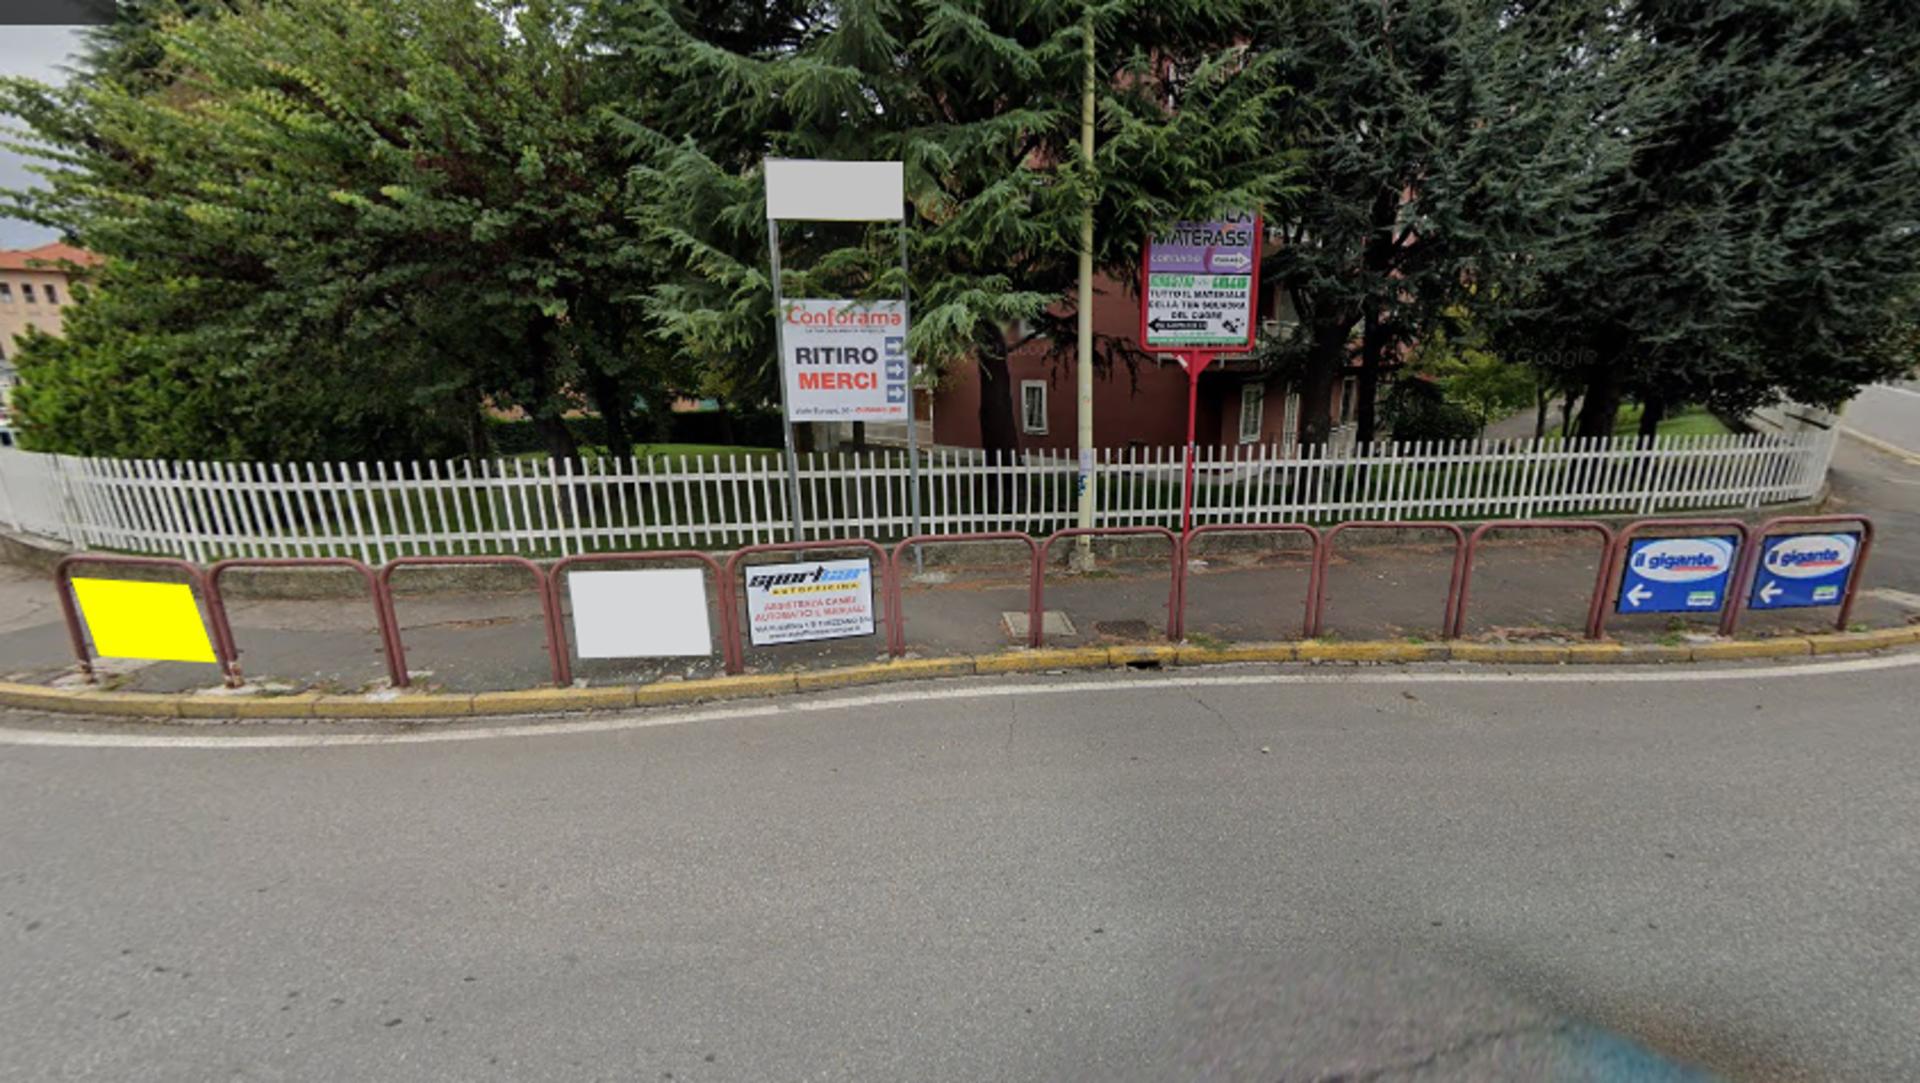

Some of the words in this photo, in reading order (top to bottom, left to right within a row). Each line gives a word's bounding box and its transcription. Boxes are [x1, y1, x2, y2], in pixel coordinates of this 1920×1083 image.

[1150, 289, 1181, 298] TUTTO
[1194, 290, 1246, 299] MATERIALE
[787, 305, 903, 327] Conforama
[796, 347, 878, 365] RITIRO
[799, 372, 878, 390] MERCI
[1648, 552, 1715, 570] gigante
[1780, 548, 1840, 567] gigante
